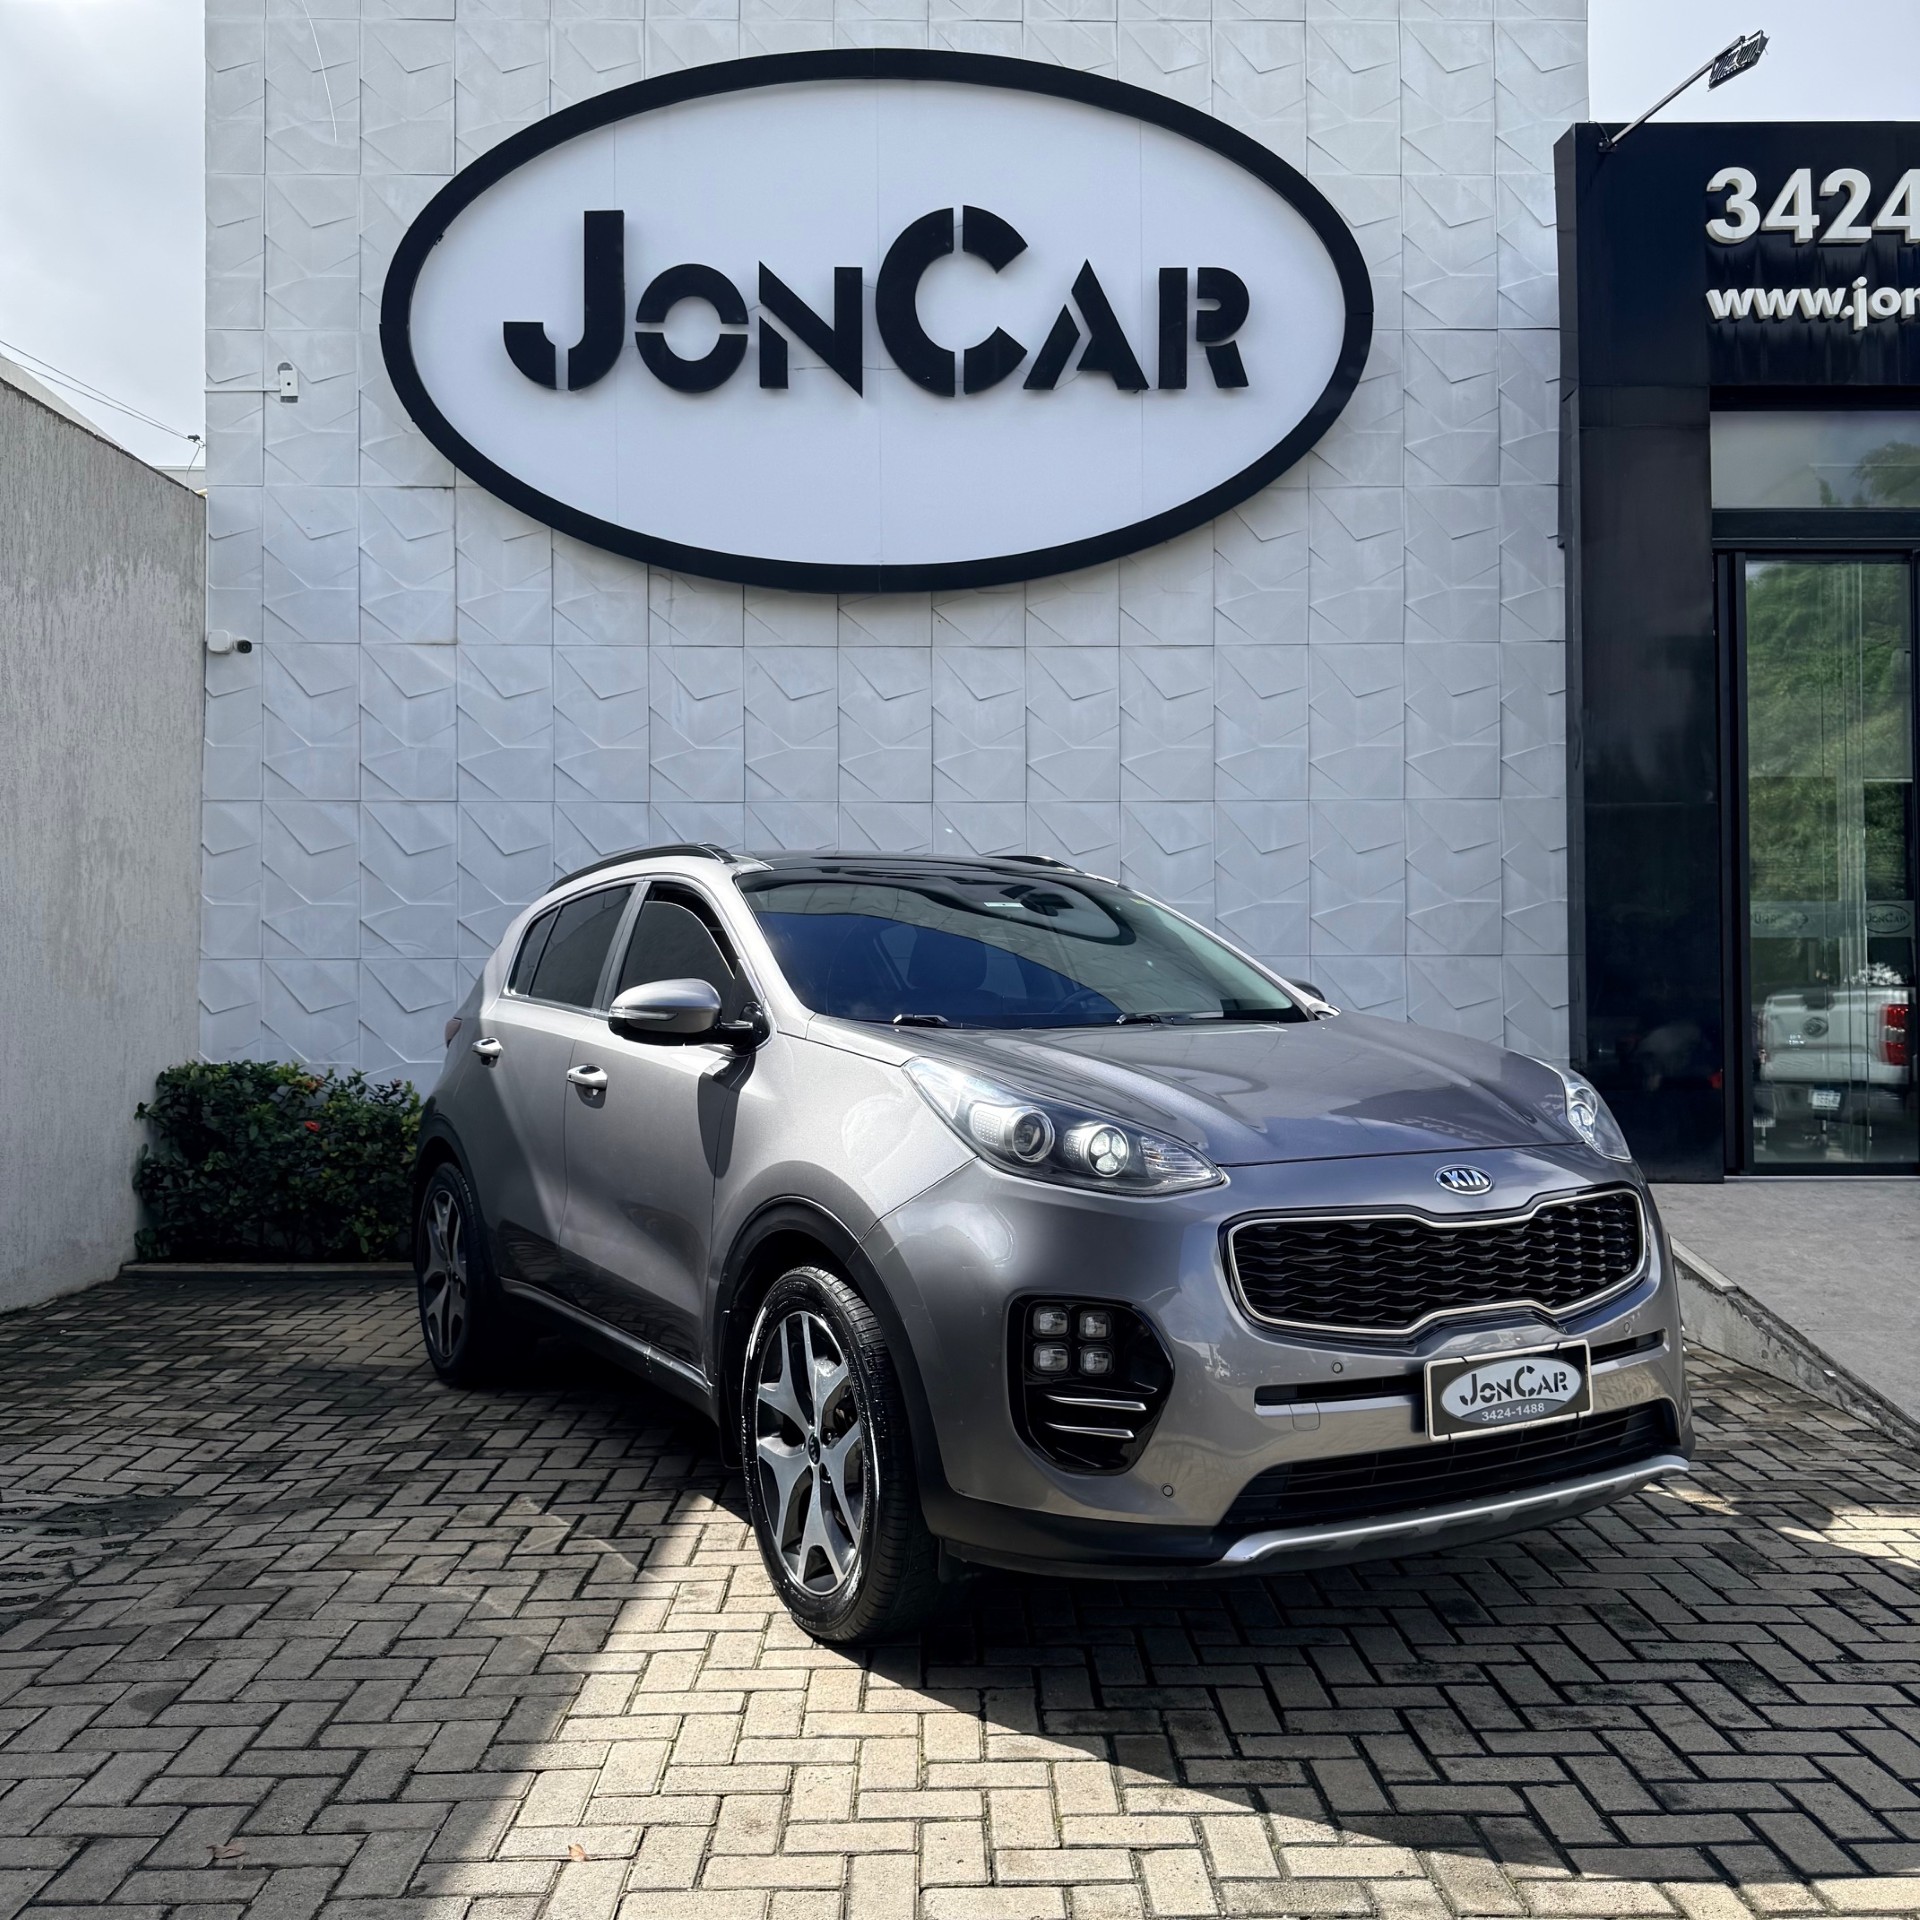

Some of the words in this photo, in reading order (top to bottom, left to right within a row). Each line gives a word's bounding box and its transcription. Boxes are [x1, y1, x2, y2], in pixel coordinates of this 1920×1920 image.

[1706, 167, 1920, 243] 3424
[1443, 1170, 1489, 1188] KIA
[1482, 1403, 1545, 1421] 3424-1488
